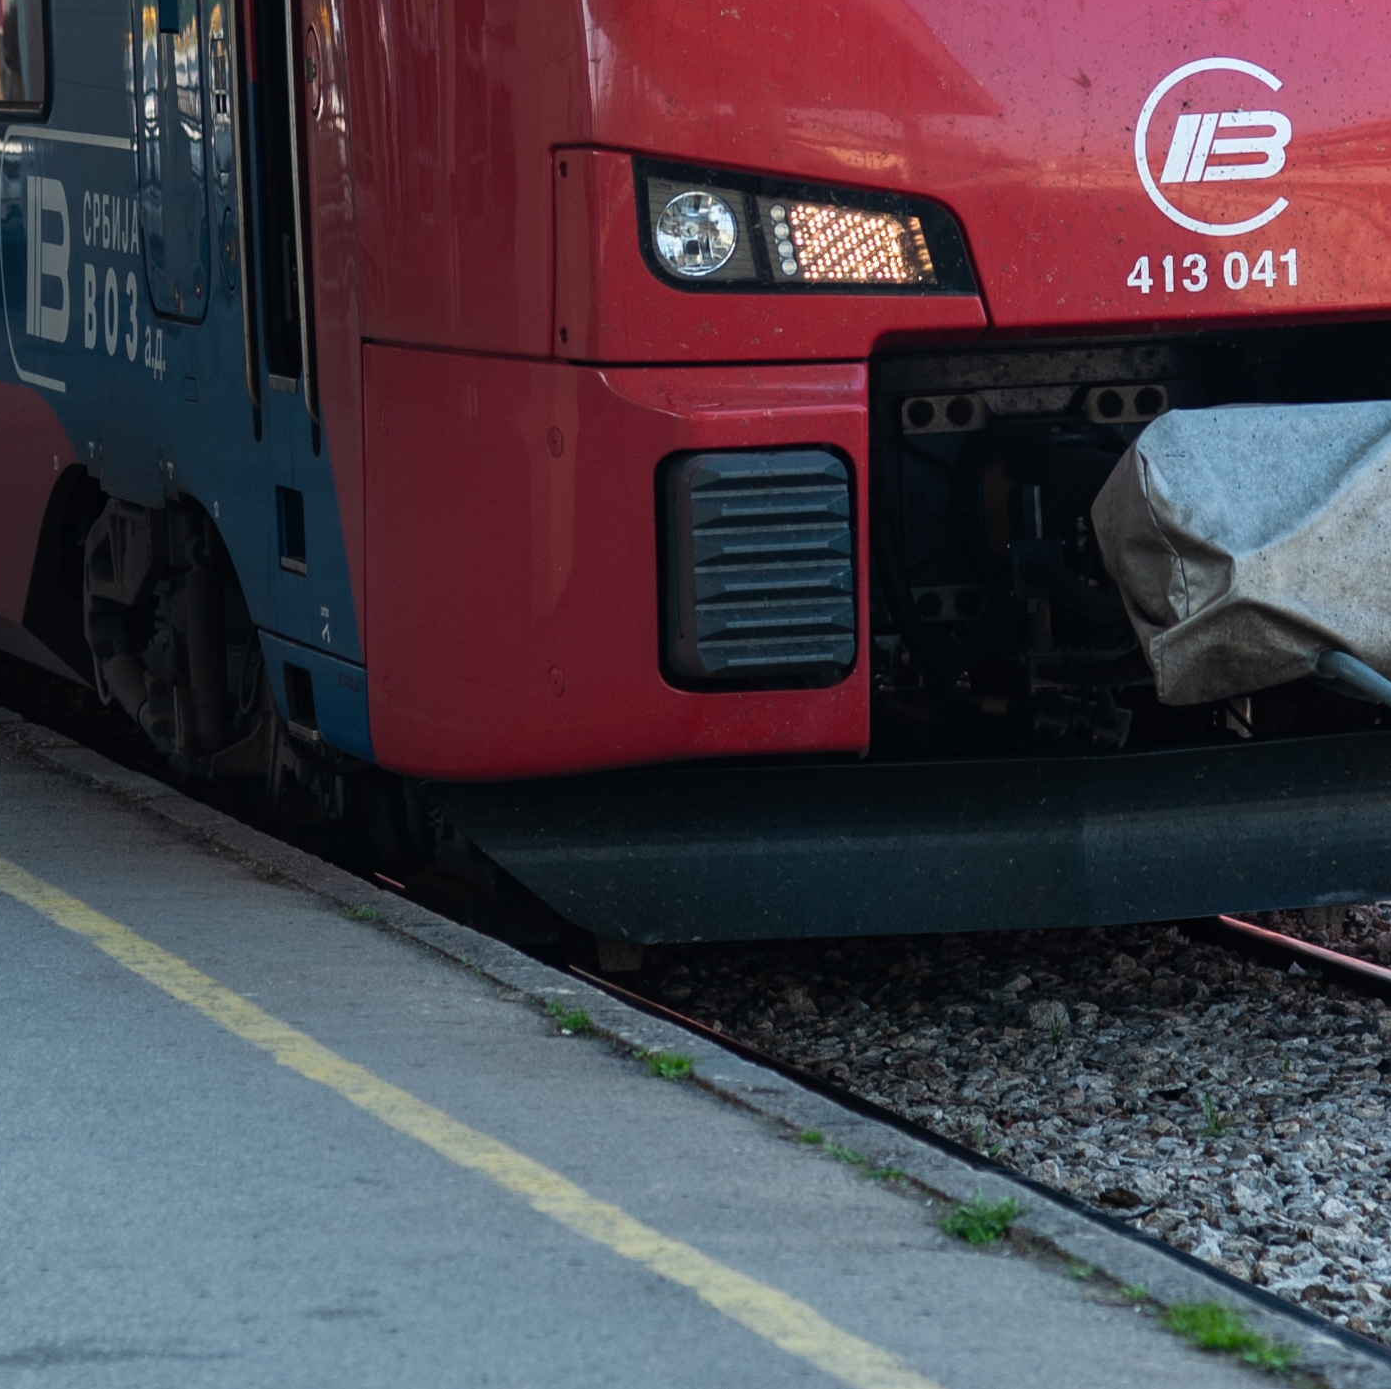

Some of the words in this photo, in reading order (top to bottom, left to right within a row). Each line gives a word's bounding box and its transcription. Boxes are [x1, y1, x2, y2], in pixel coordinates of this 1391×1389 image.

[83, 190, 140, 255] СРБИЈА
[1127, 253, 1208, 294] 413
[1223, 248, 1297, 290] 041
[84, 263, 138, 362] ВОЗ
[144, 325, 166, 382] а.д.
